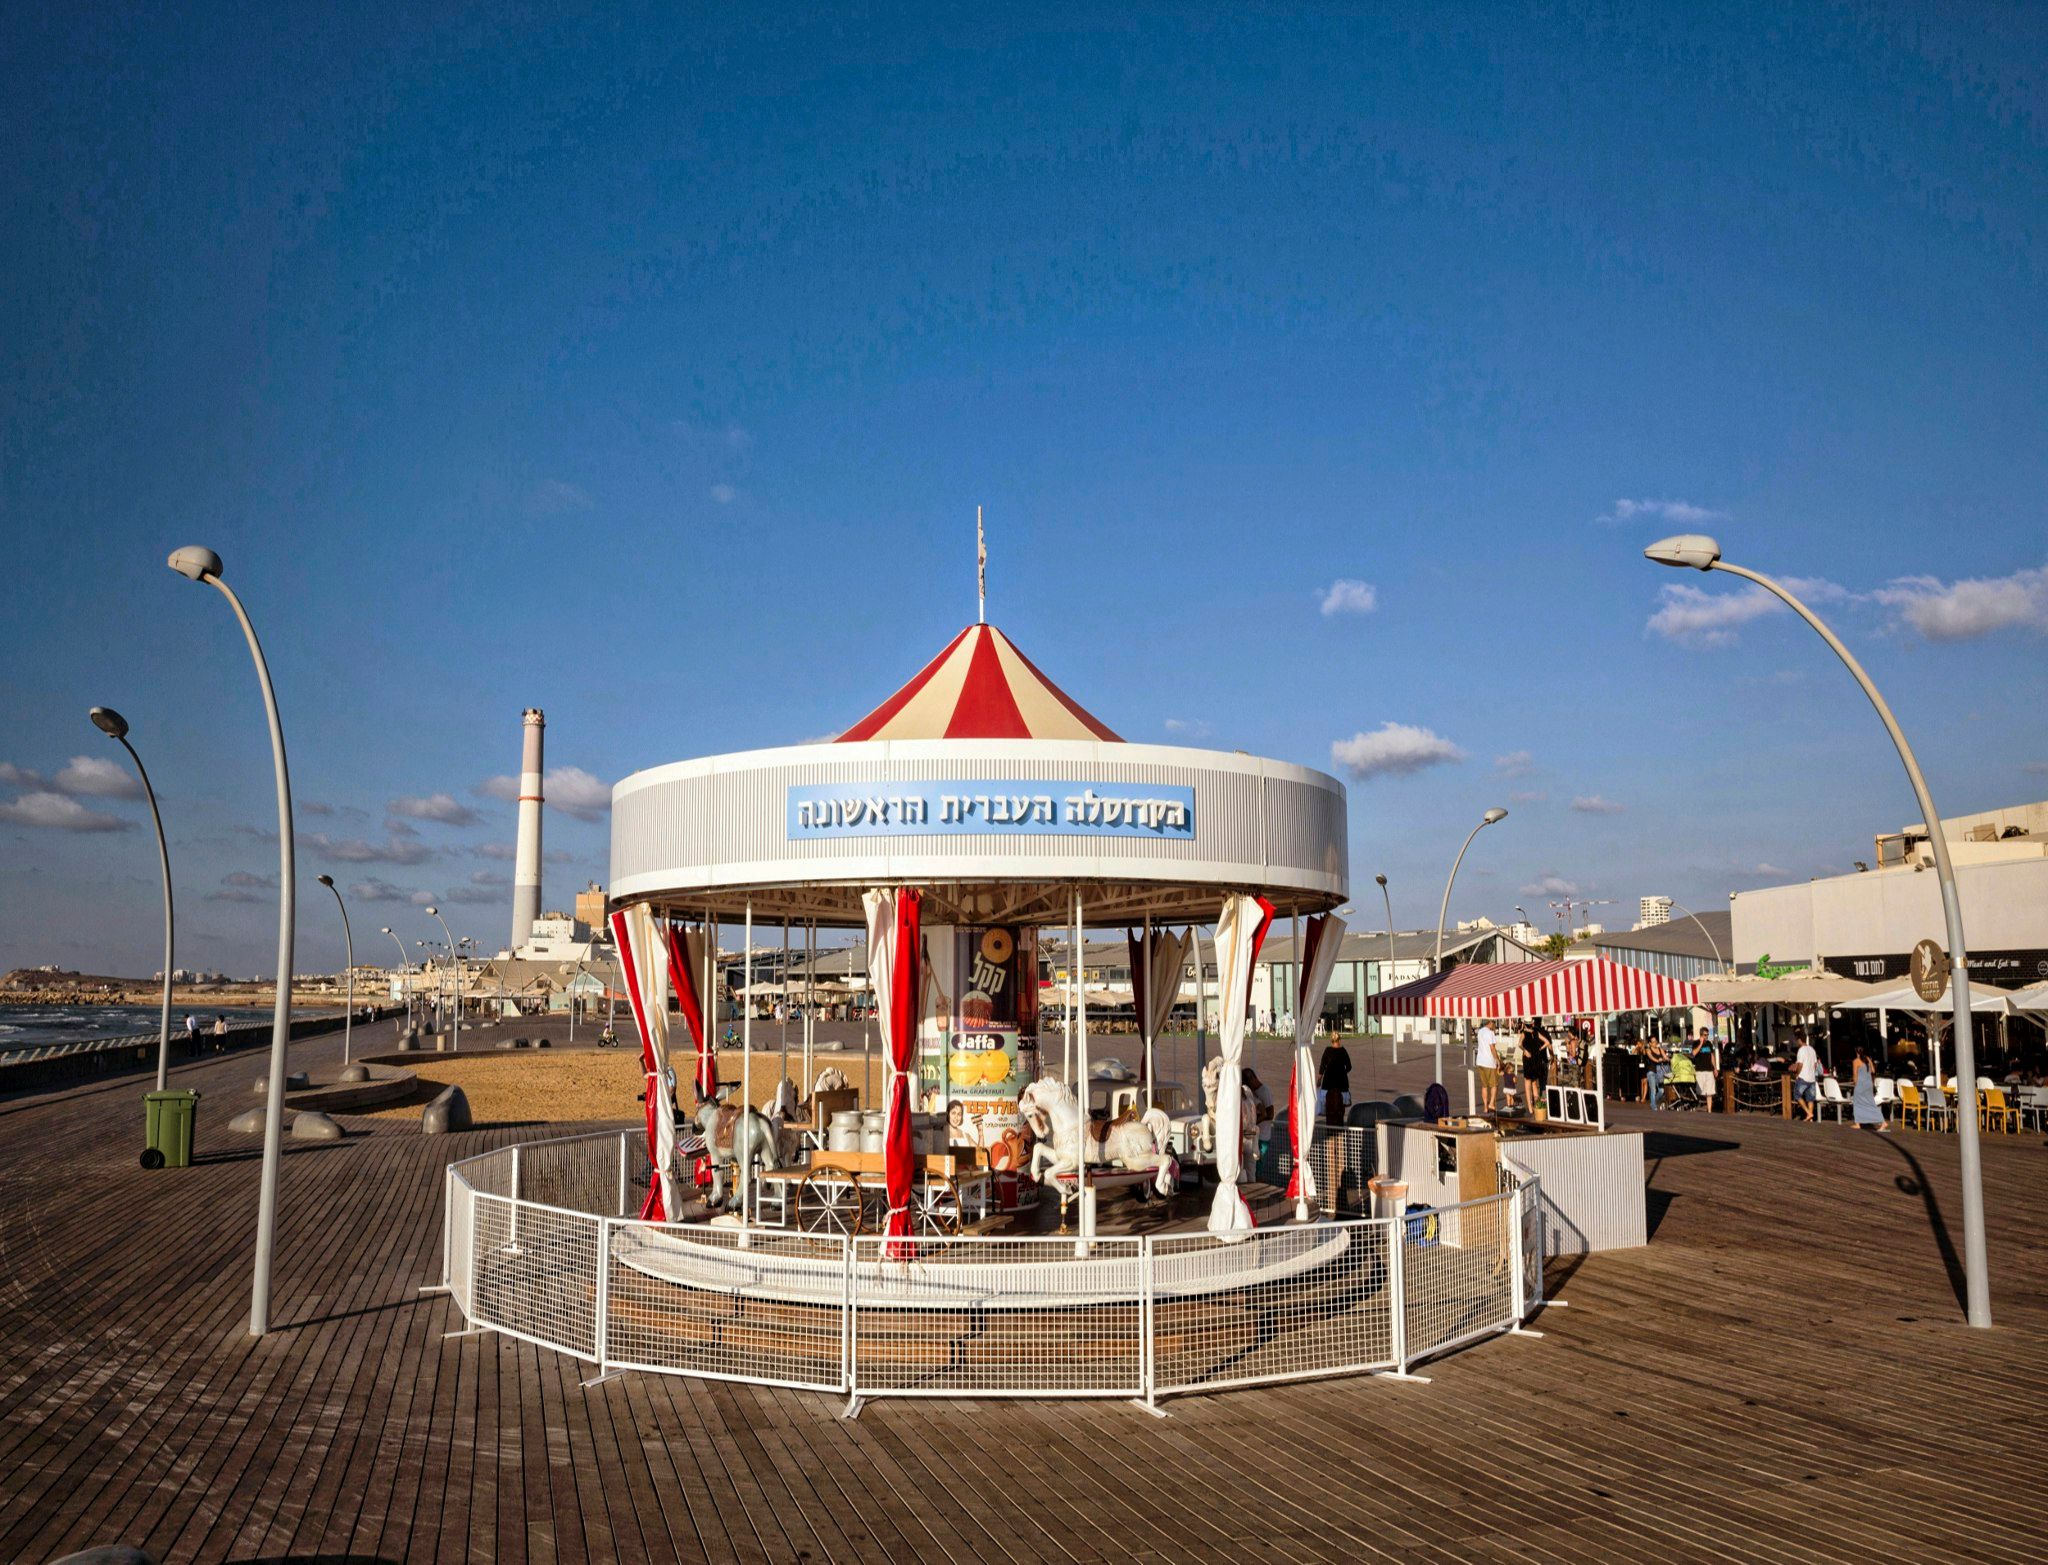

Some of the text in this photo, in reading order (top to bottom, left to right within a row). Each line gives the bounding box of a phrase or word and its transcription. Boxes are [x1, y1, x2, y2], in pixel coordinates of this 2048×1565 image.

[798, 788, 1186, 828] הקרוסלה העברית הראשונה
[1853, 959, 1885, 976] לחם בשר
[957, 1033, 996, 1050] Jaffa
